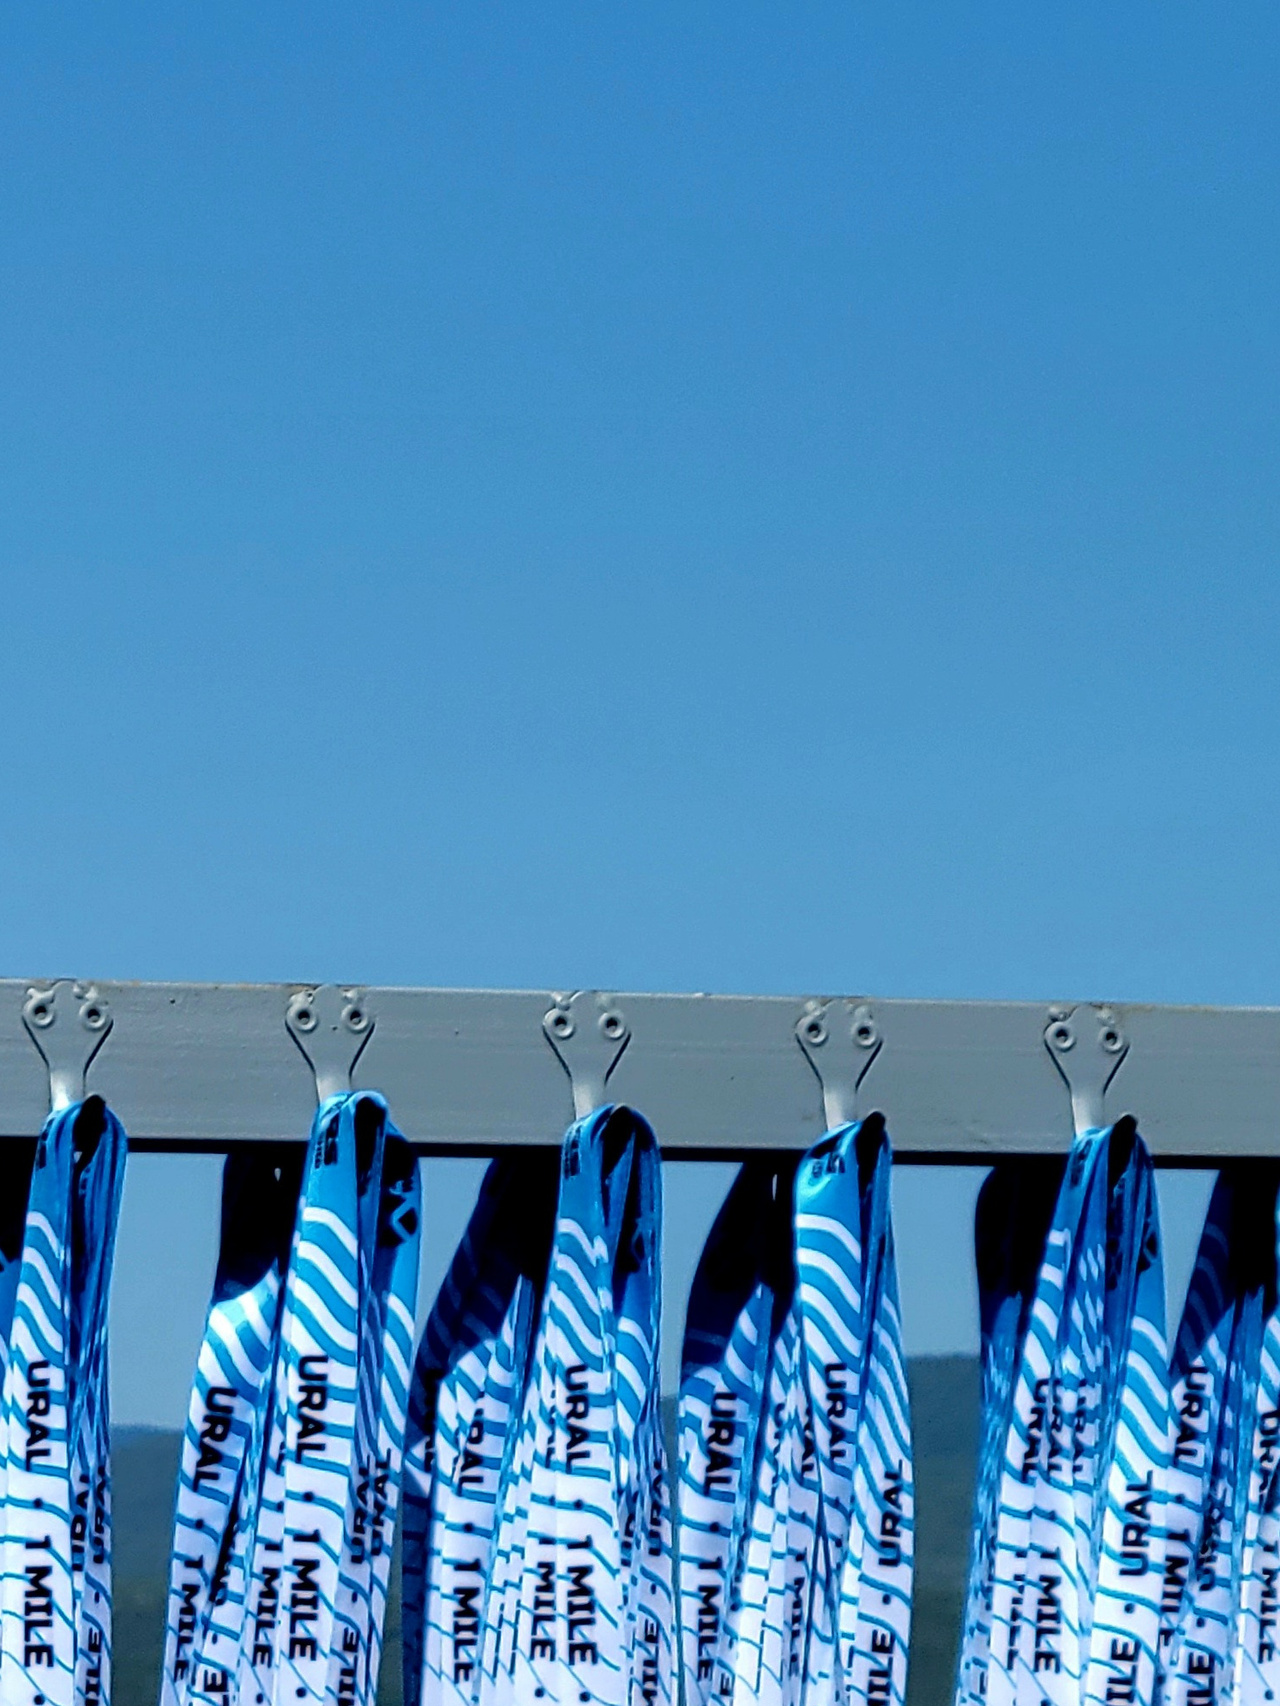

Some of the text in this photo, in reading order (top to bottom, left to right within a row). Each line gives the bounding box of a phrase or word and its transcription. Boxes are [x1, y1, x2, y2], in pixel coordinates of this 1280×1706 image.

[27, 1361, 51, 1472] URAL
[193, 1386, 238, 1493] URAL
[295, 1356, 328, 1464] URAL
[566, 1364, 591, 1474] URAL
[823, 1364, 847, 1470] URAL
[1174, 1365, 1208, 1468] URAL
[25, 1536, 51, 1550] 1
[293, 1530, 320, 1542] 1
[567, 1535, 593, 1549] 1
[698, 1392, 737, 1682] URAL 1 MILE
[879, 1460, 902, 1567] URAL
[1040, 1547, 1060, 1560] 1
[1120, 1470, 1153, 1576] URAL
[1168, 1528, 1189, 1542] 1
[24, 1565, 54, 1669] MILE
[173, 1584, 200, 1682] MILE
[252, 1568, 281, 1668] MILE
[288, 1558, 320, 1661] MILE
[453, 1558, 481, 1685] 1 MILE
[530, 1561, 556, 1661] MILE
[567, 1565, 598, 1666] MILE
[1035, 1575, 1061, 1674] MILE
